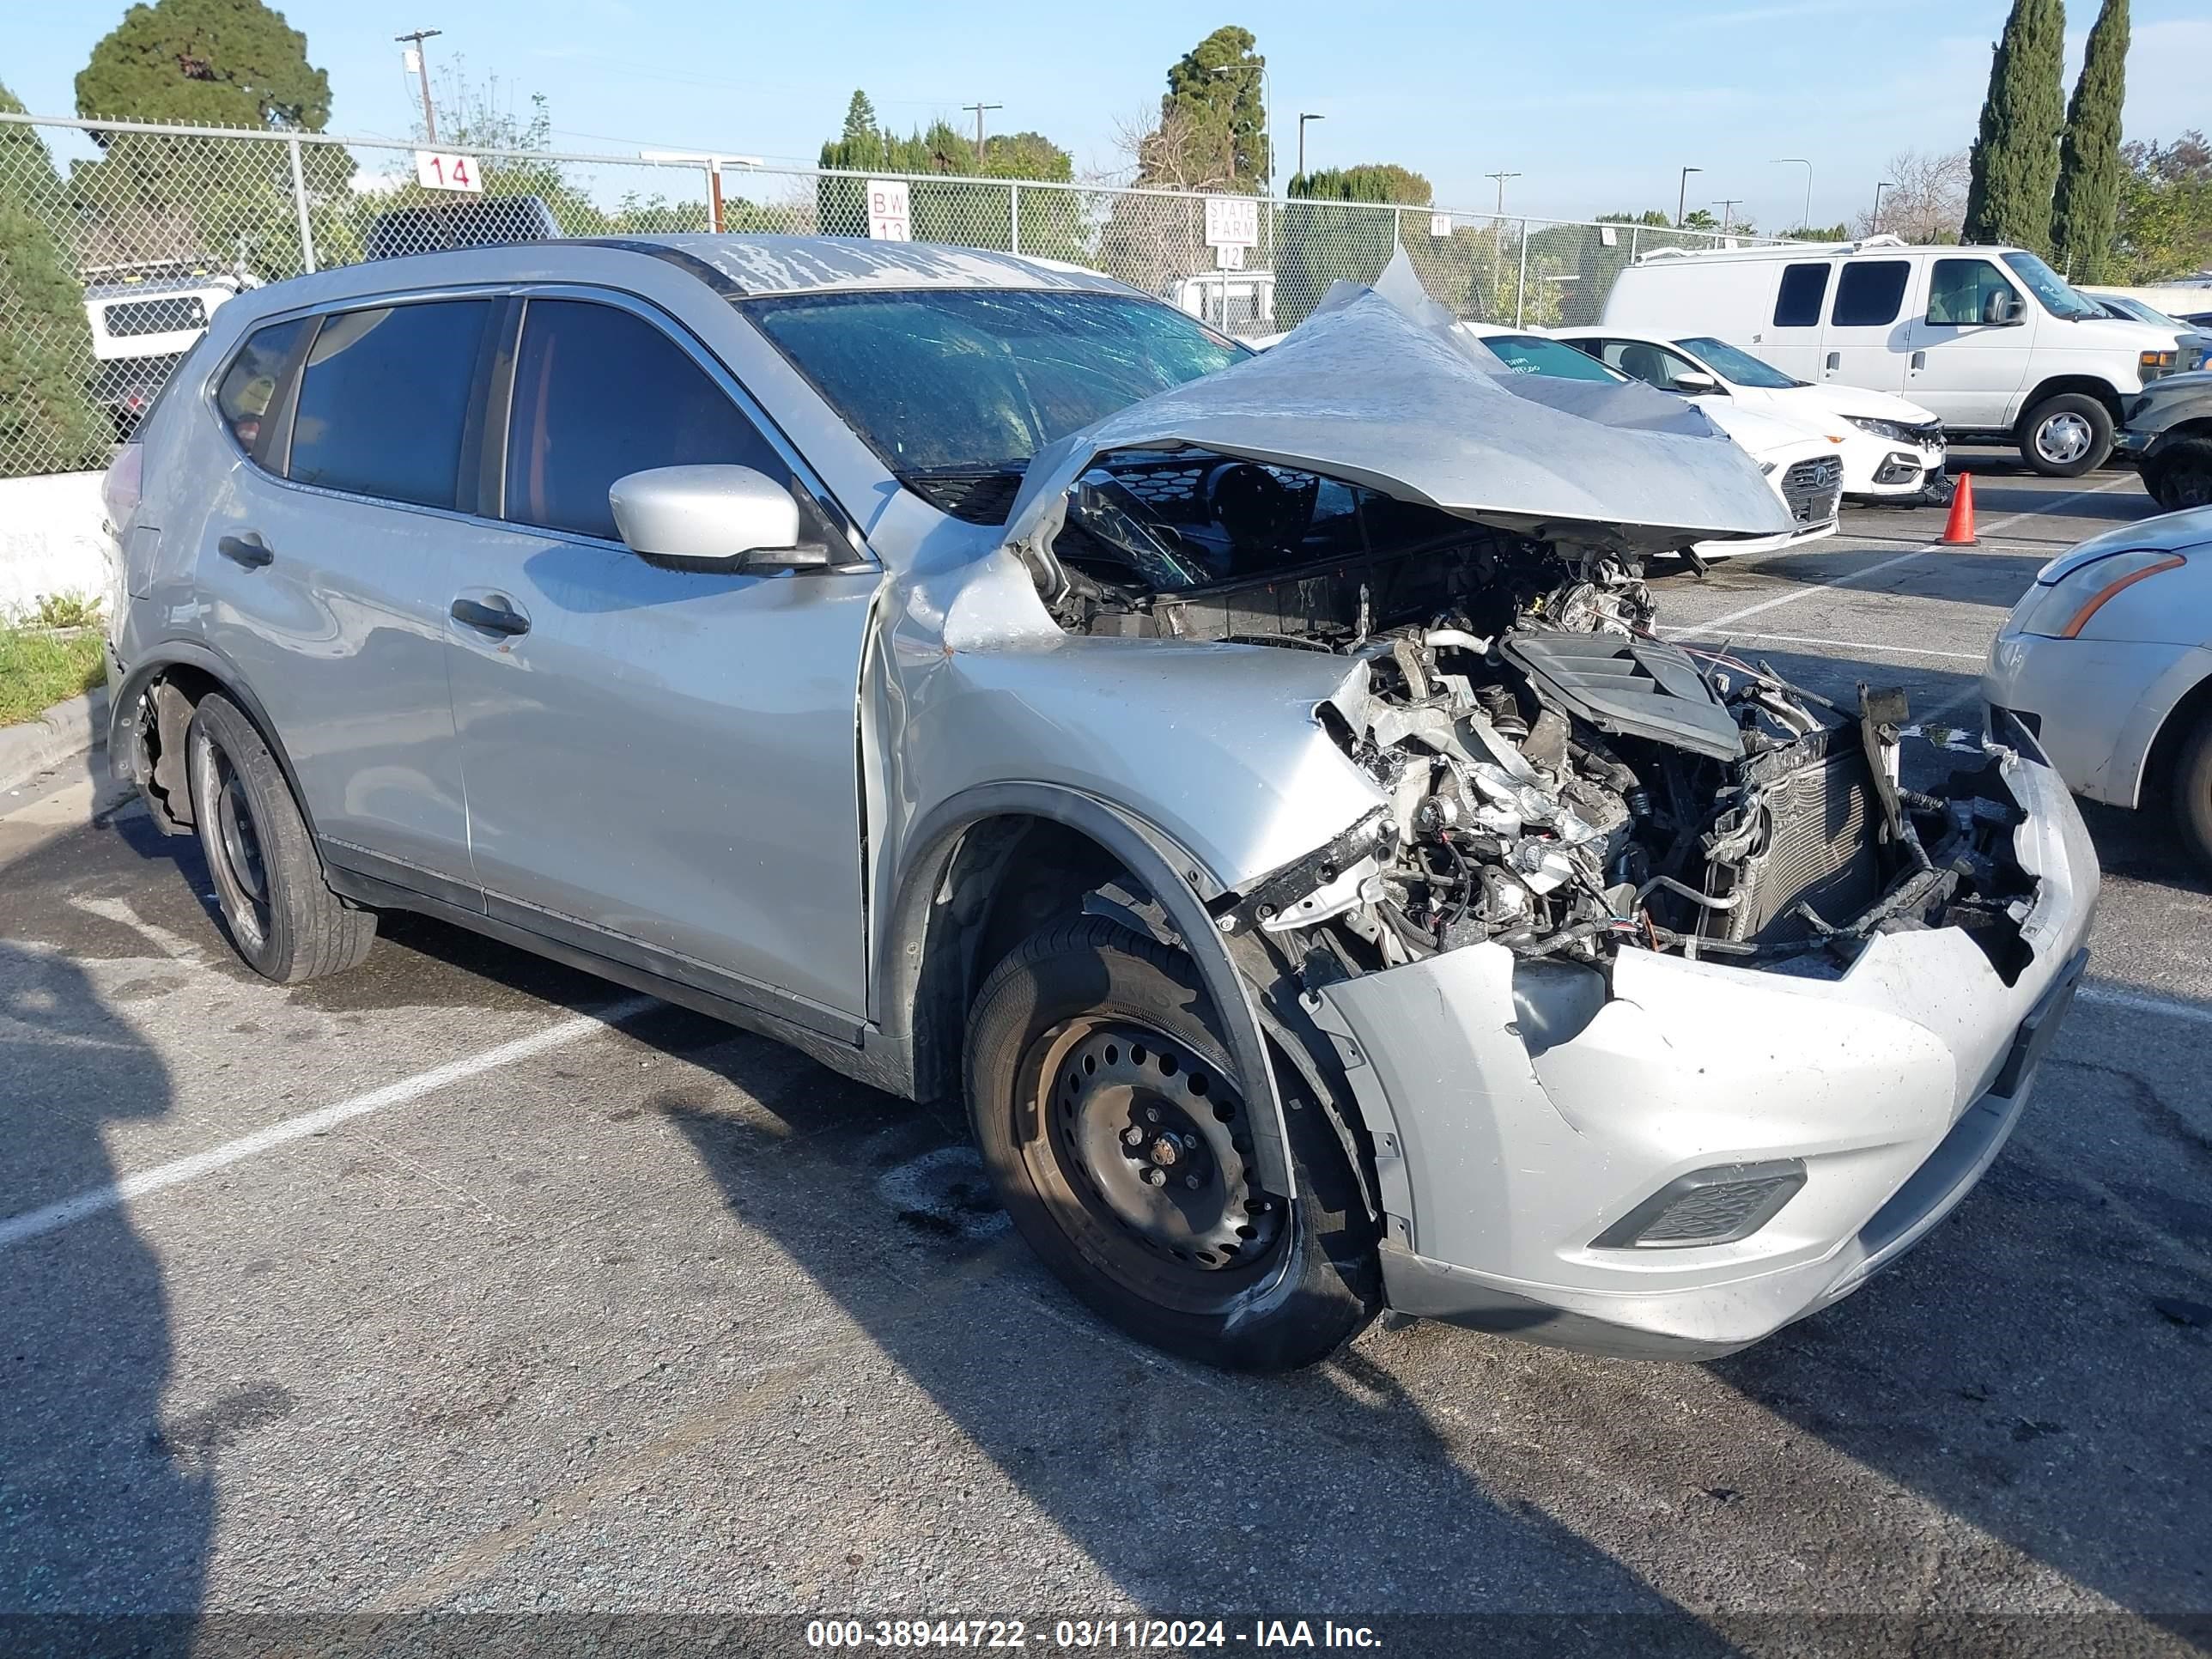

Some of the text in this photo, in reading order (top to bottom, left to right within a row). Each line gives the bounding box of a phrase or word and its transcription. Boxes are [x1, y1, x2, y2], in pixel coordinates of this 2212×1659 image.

[430, 156, 469, 187] 14
[1210, 201, 1255, 220] STATE
[1212, 220, 1254, 238] FARM
[1224, 246, 1239, 266] 12
